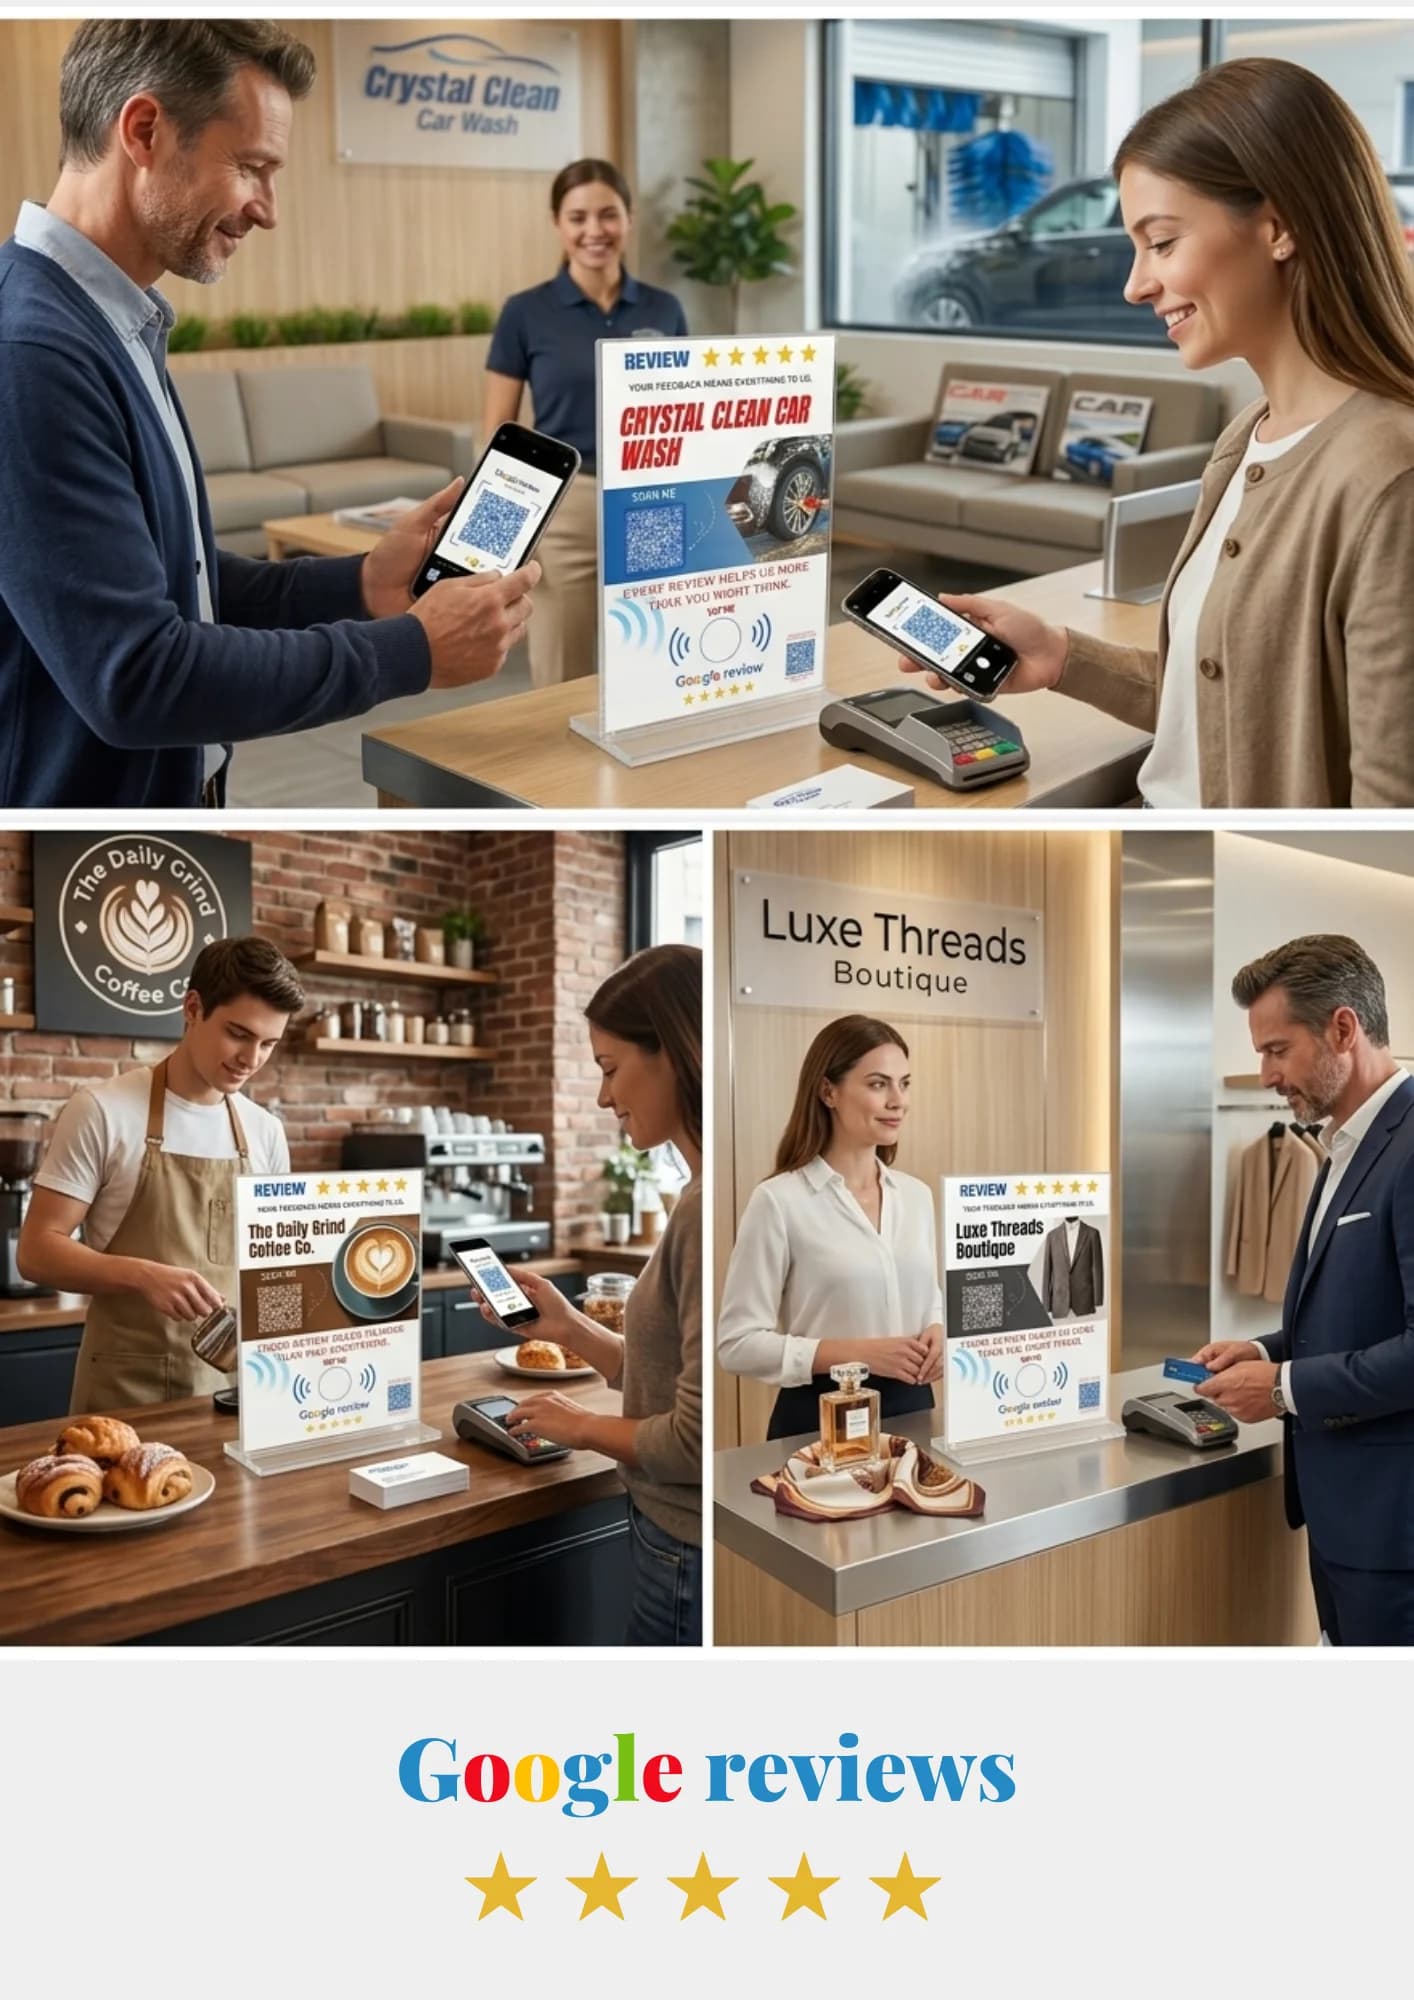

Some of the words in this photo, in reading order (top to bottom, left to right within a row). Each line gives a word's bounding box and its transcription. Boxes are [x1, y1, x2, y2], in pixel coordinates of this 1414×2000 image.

[364, 64, 476, 106] Crystal
[483, 75, 561, 112] Clean
[416, 108, 456, 131] Car
[461, 111, 519, 136] Wash
[624, 350, 690, 371] REVIEW
[620, 402, 705, 437] CRYSTAL
[711, 397, 773, 431] CLEAN
[774, 395, 812, 425] CAR
[1073, 396, 1144, 417] CAR
[621, 437, 683, 471] WASH
[777, 561, 809, 576] MORE
[73, 864, 108, 902] The
[107, 845, 165, 870] Daily
[170, 860, 216, 917] Grind
[762, 898, 863, 948] Luxe
[874, 912, 1026, 966] Threads
[94, 964, 164, 1004] Coffee
[834, 960, 968, 996] Boutique
[253, 1181, 307, 1198] REVIEW
[960, 1182, 1008, 1198] REVIEW
[248, 1223, 273, 1240] The
[276, 1220, 309, 1240] Daily
[956, 1222, 988, 1240] Luxe
[990, 1218, 1044, 1238] Threads
